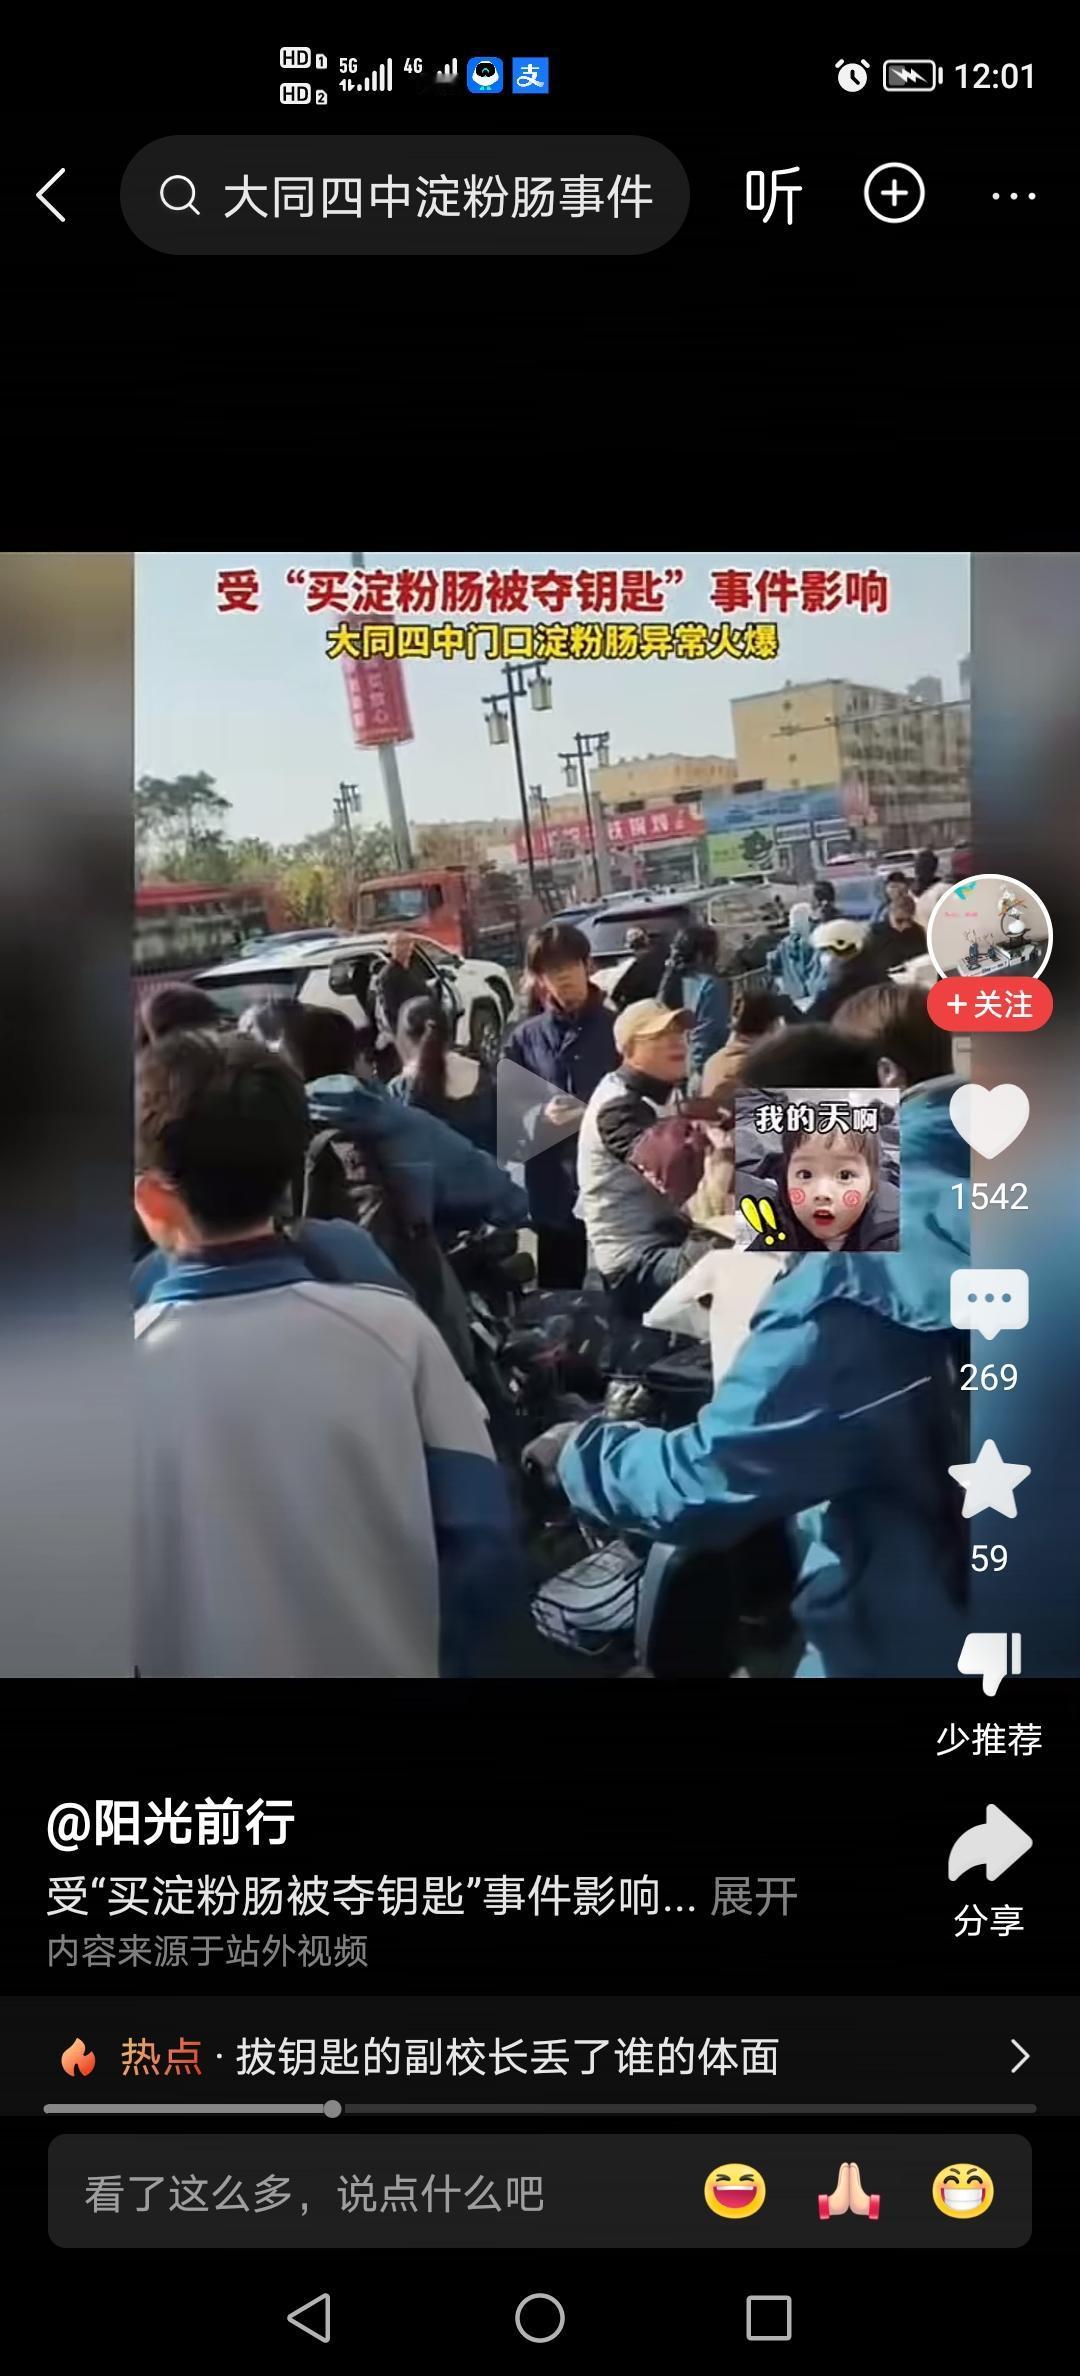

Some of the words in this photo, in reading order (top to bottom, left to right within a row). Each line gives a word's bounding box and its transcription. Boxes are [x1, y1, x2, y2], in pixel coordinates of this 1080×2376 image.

[282, 49, 309, 67] HD
[339, 57, 358, 73] 5G
[403, 57, 423, 73] 4G
[955, 62, 1033, 90] 12:01
[282, 85, 309, 103] HD
[224, 173, 653, 219] 大同四中淀粉肠事件
[745, 165, 803, 226] 听
[974, 989, 1033, 1019] 关注
[951, 1182, 1029, 1210] 1542
[959, 1363, 1018, 1391] 269
[971, 1544, 1009, 1572] 59
[936, 1722, 1043, 1757] 少推荐
[47, 1796, 295, 1852] @阳光前行
[710, 1876, 798, 1917] 展开
[953, 1903, 1026, 1938] 分享
[48, 1933, 368, 1968] 内容来源于站外视频
[120, 2036, 202, 2077] 热点
[235, 2036, 780, 2077] 拔钥匙的副校长丢了谁的体面
[84, 2173, 544, 2217] 看了这么多，说点什么吧
